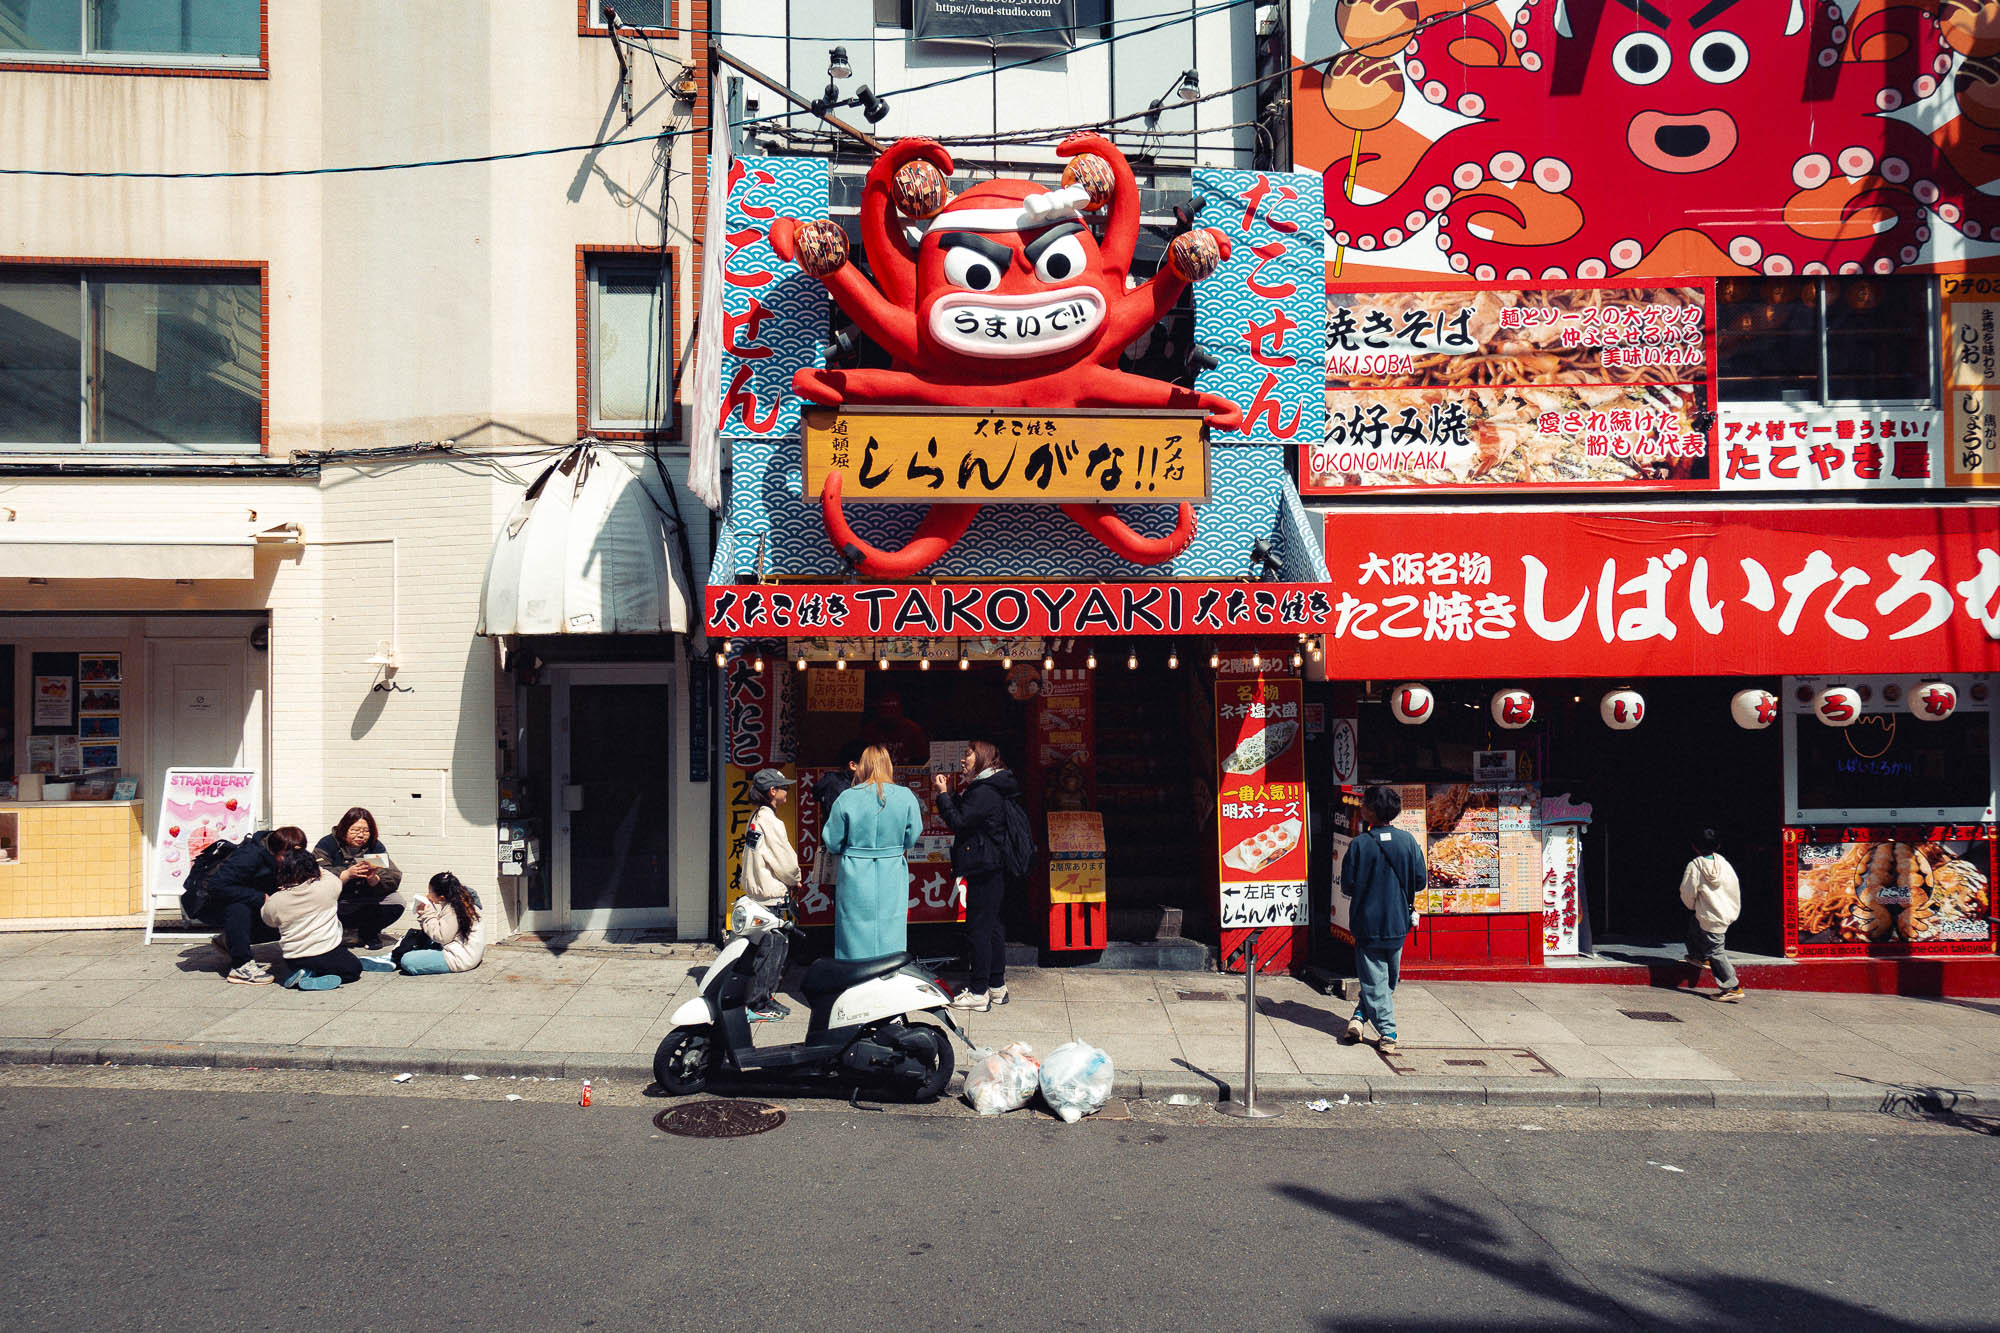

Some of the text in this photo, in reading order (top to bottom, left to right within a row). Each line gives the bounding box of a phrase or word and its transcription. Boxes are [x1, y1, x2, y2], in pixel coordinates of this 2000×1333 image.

[935, 3, 1051, 17] https://loud-studio.com
[1239, 174, 1302, 440] たこせん
[1500, 304, 1702, 329] 麺とソースの大ゲンカ
[954, 305, 1086, 339] うまいで!!
[1325, 306, 1477, 352] 焼きそば
[1562, 327, 1702, 348] 仲よさせるから
[1961, 324, 1979, 364] しお
[1602, 347, 1702, 366] 美味いねん
[973, 418, 1057, 437] 大たこ焼き
[1324, 403, 1471, 449] お好み焼
[1538, 410, 1680, 434] 愛され続けた
[1724, 420, 1931, 441] アメ村で一番うまい!
[1963, 394, 1982, 471] しょうゆ
[830, 420, 850, 469] 道頓堀
[1586, 434, 1705, 458] 粉もん代表
[858, 434, 1156, 492] しらんがな!!
[1162, 435, 1185, 481] アメ村
[1311, 451, 1447, 473] OKONOMIYAKI
[1725, 442, 1932, 480] たこやき屋
[1358, 552, 1493, 586] 大阪名物
[709, 587, 1332, 633] 大たこ焼き TAKOYAKI 大たこ焼き
[1334, 590, 1517, 642] たこ焼き
[1237, 685, 1280, 701] 名物
[729, 658, 766, 767] 大たこ
[1220, 702, 1298, 720] ネギ塩大盛
[1401, 690, 1430, 718] し
[1502, 696, 1533, 725] ば
[1613, 699, 1642, 722] い
[1821, 694, 1854, 721] ろ
[1921, 688, 1955, 717] か
[170, 775, 253, 788] STRAWBERRY
[195, 786, 225, 798] MILK
[1222, 784, 1300, 802] 一番人気!!
[800, 772, 817, 862] 大たこ入り
[1222, 801, 1301, 820] 明太チーズ
[1051, 862, 1105, 872] 2階席あります
[1244, 883, 1307, 900] 左店です
[1222, 902, 1308, 925] しらんがな!!
